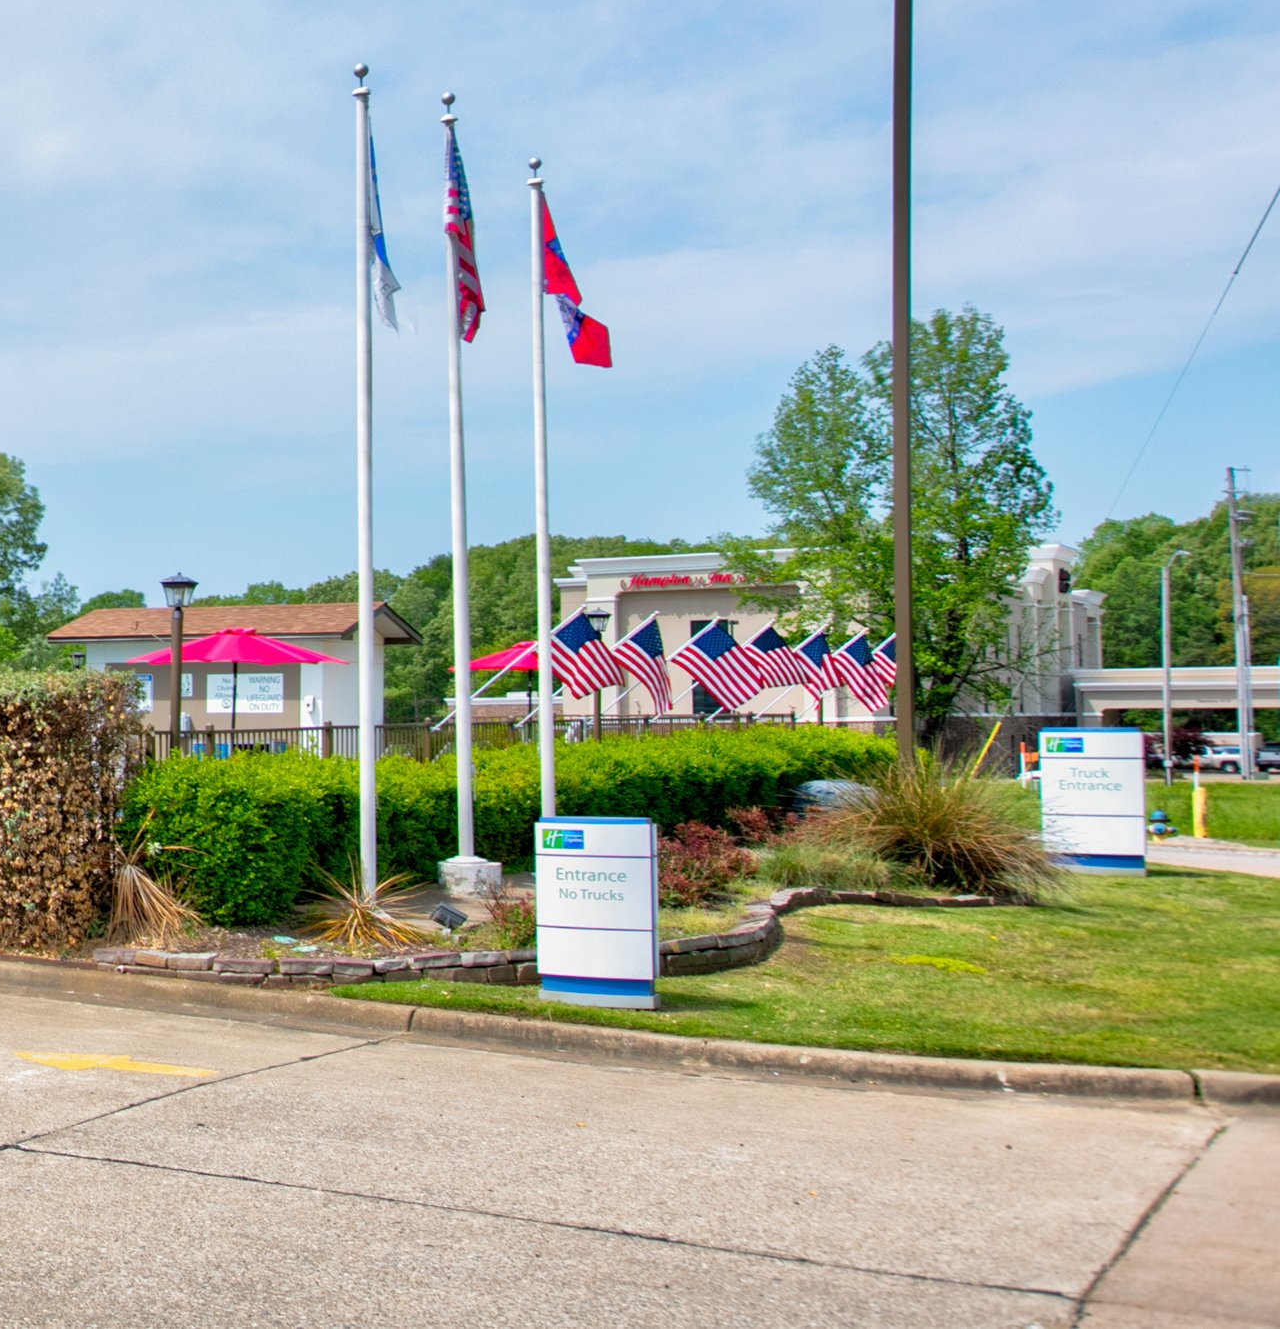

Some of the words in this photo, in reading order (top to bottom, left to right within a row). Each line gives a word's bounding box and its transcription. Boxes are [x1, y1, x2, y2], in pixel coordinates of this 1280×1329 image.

[620, 573, 692, 591] Hampton
[701, 571, 734, 588] Inn
[248, 676, 281, 684] WARNING
[259, 685, 270, 693] NO
[246, 694, 283, 702] LIFEGUARD
[249, 702, 259, 711] ON
[261, 702, 280, 711] DUTY
[1069, 767, 1110, 779] Truck
[1058, 779, 1123, 792] Entrance
[556, 867, 628, 883] Entrance
[559, 888, 578, 900] No
[580, 888, 625, 902] Trucks
